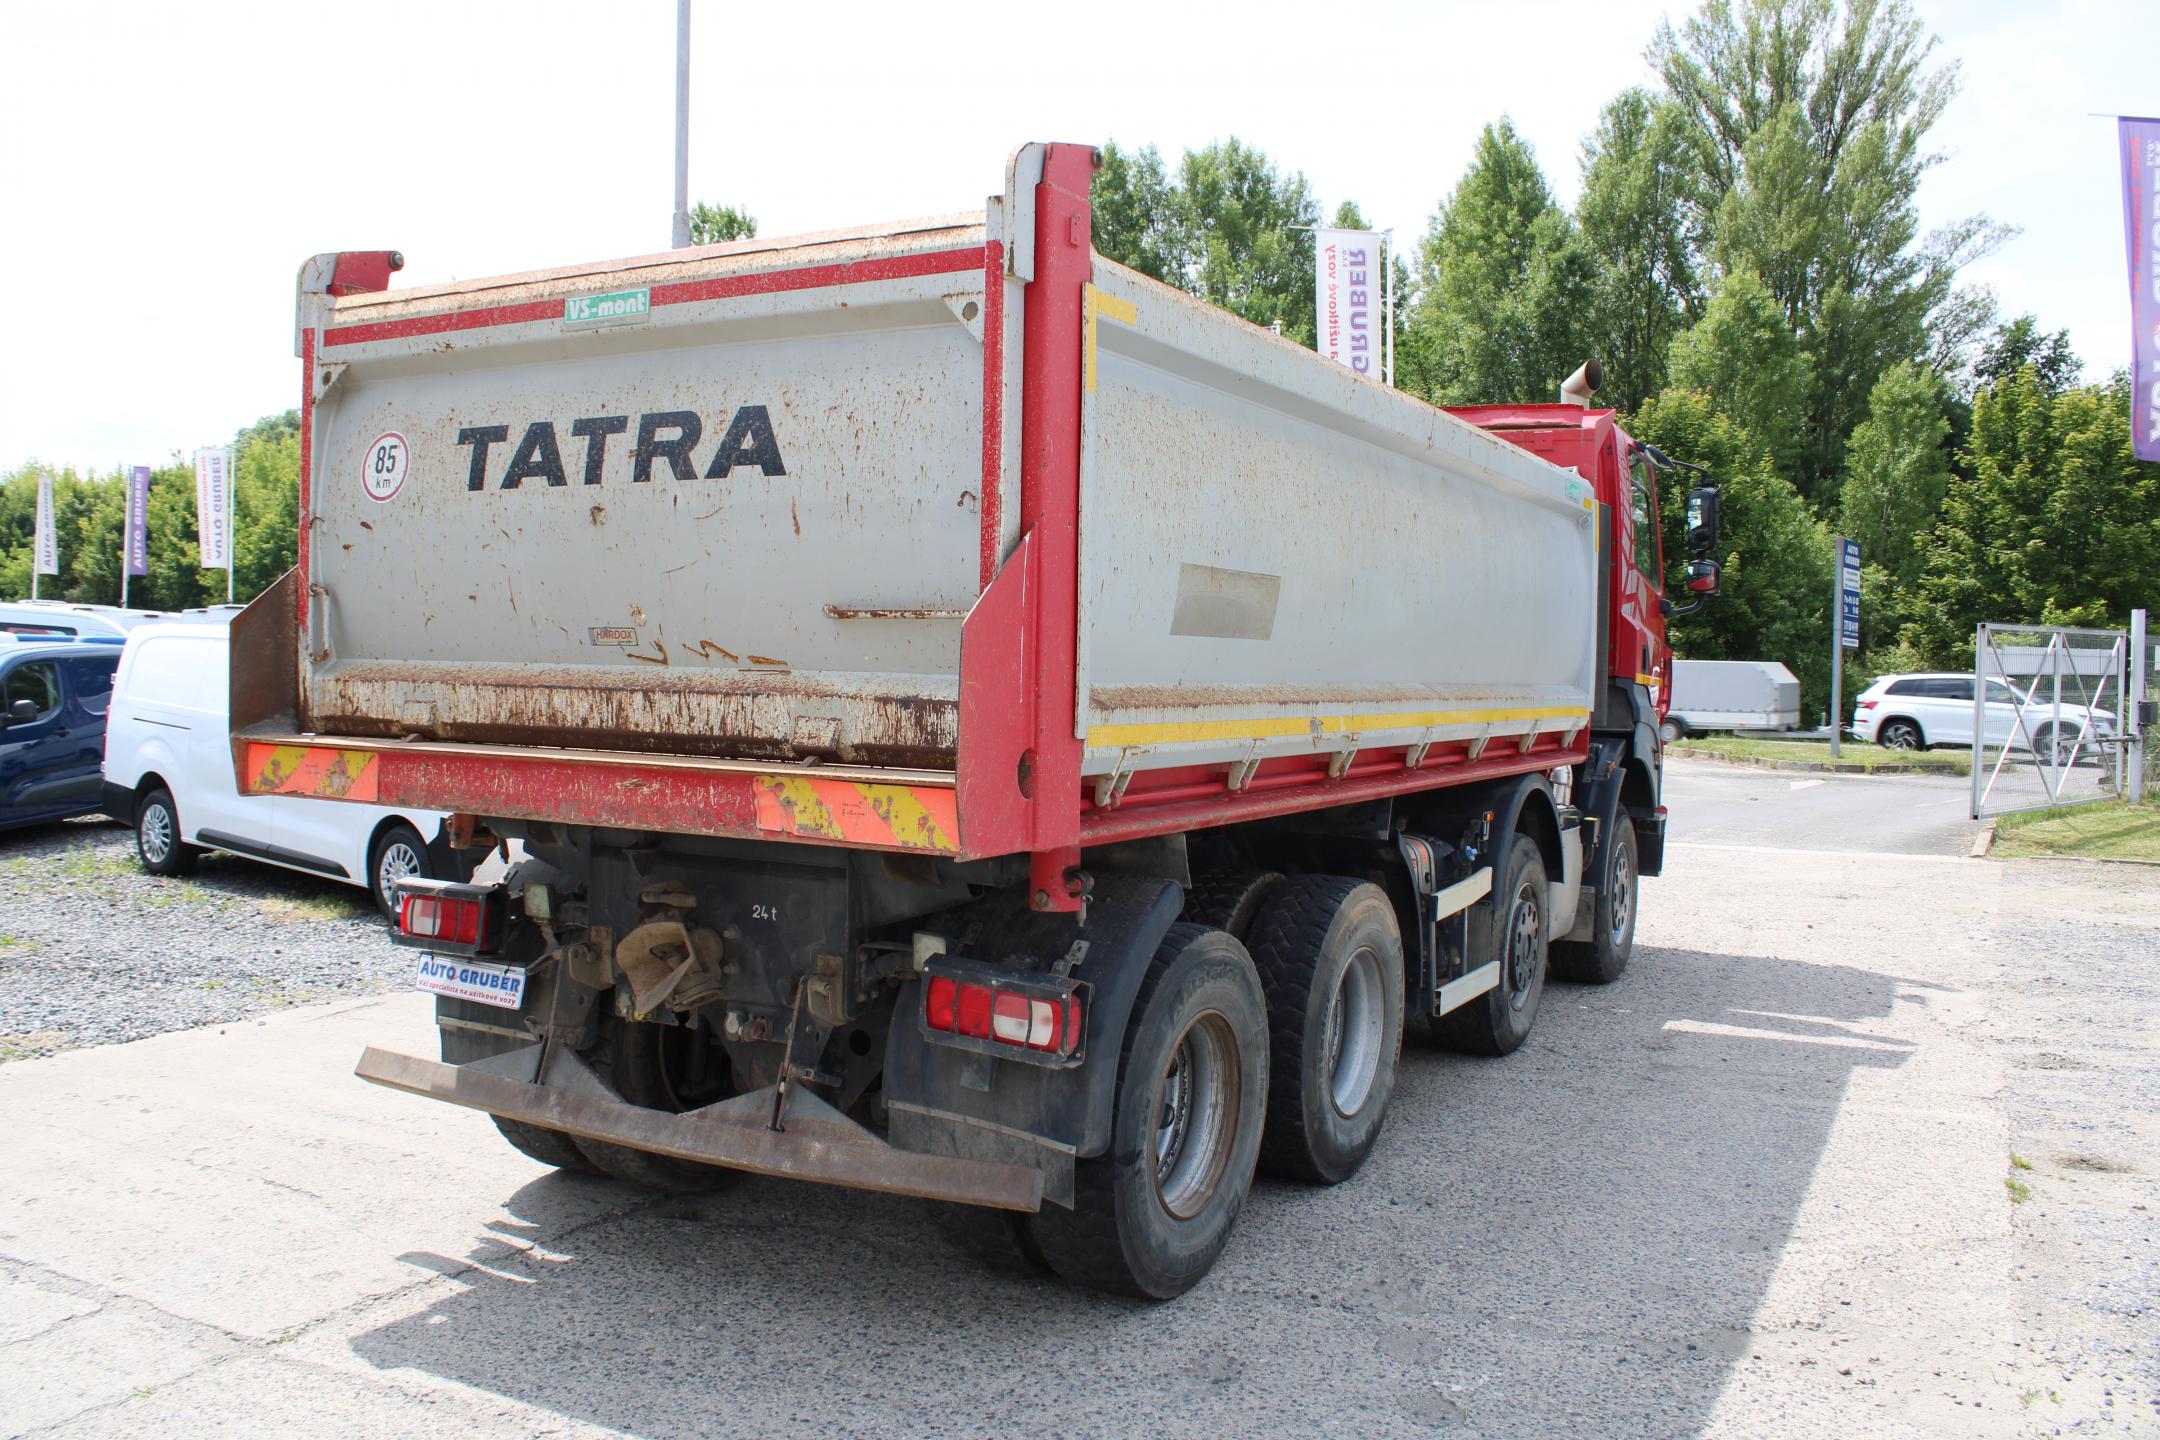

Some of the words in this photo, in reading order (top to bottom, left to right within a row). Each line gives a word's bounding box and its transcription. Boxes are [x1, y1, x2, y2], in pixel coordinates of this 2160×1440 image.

[569, 293, 646, 320] VS-mont
[375, 445, 398, 474] 85
[457, 405, 787, 491] TATRA
[376, 477, 391, 489] km
[133, 530, 142, 568] AUTO
[596, 630, 632, 639] HARDOX
[752, 904, 768, 920] 24
[771, 907, 777, 921] t
[420, 961, 456, 981] AUTO
[459, 968, 521, 993] GRUBER
[499, 997, 516, 1006] vozy
